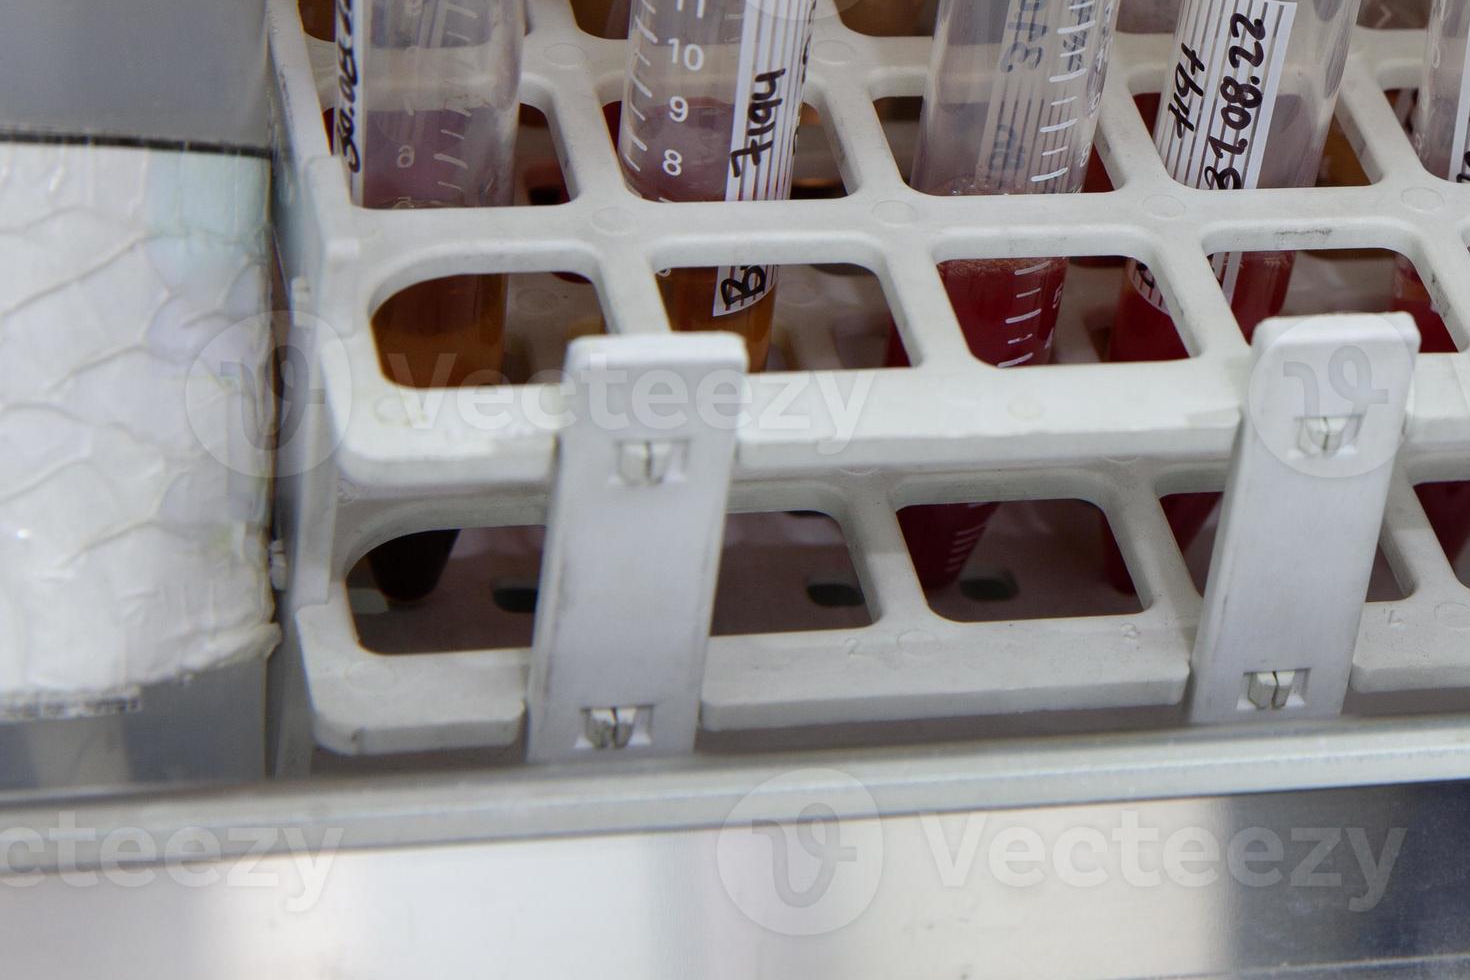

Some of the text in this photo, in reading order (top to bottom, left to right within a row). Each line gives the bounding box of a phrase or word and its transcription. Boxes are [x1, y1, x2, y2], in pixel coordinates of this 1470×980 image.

[667, 38, 705, 71] 10
[669, 95, 689, 122] 9
[731, 68, 786, 177] 7194
[662, 149, 683, 176] 8
